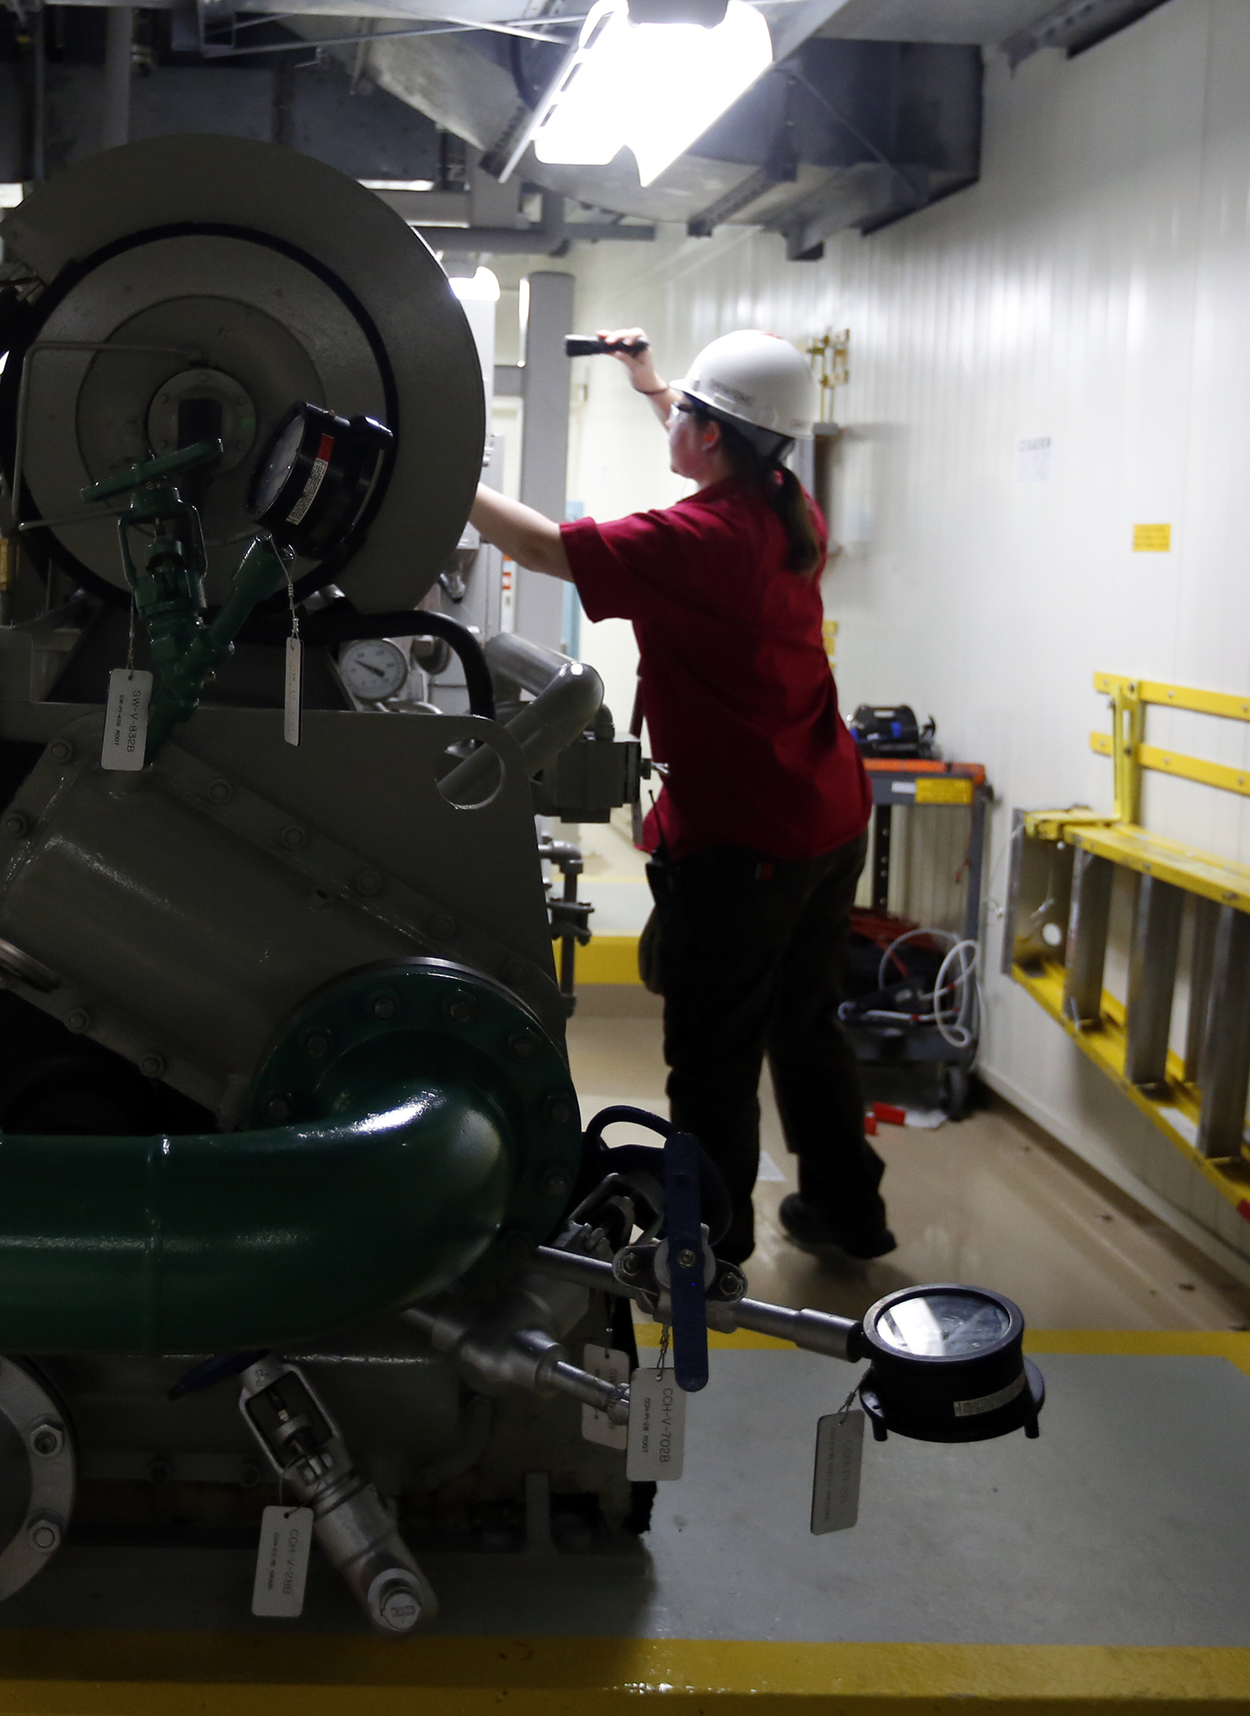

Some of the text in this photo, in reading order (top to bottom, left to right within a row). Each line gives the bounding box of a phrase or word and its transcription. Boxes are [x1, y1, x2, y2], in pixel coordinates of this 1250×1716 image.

[126, 690, 142, 753] SW-V-832B
[659, 1387, 673, 1463] CCH-V-702B
[282, 1528, 299, 1595] CCH-V-28B
